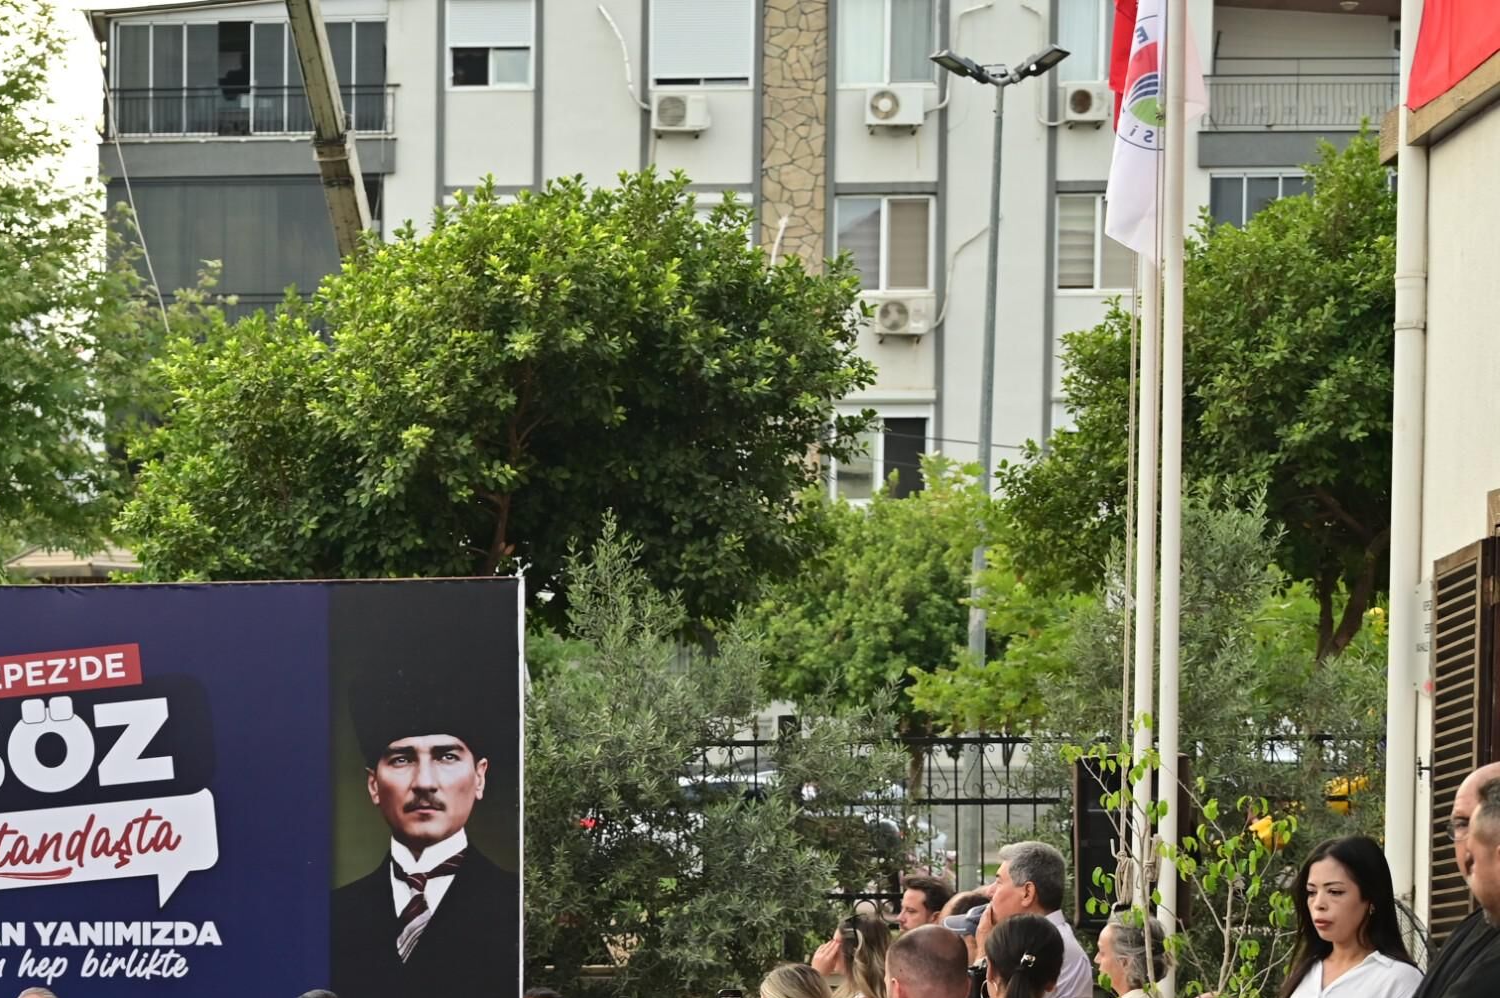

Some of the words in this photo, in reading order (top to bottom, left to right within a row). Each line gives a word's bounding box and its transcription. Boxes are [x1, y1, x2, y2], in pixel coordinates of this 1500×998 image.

[33, 921, 223, 947] YANIMIZDA
[17, 948, 69, 985] hep
[80, 948, 189, 981] birlikte
